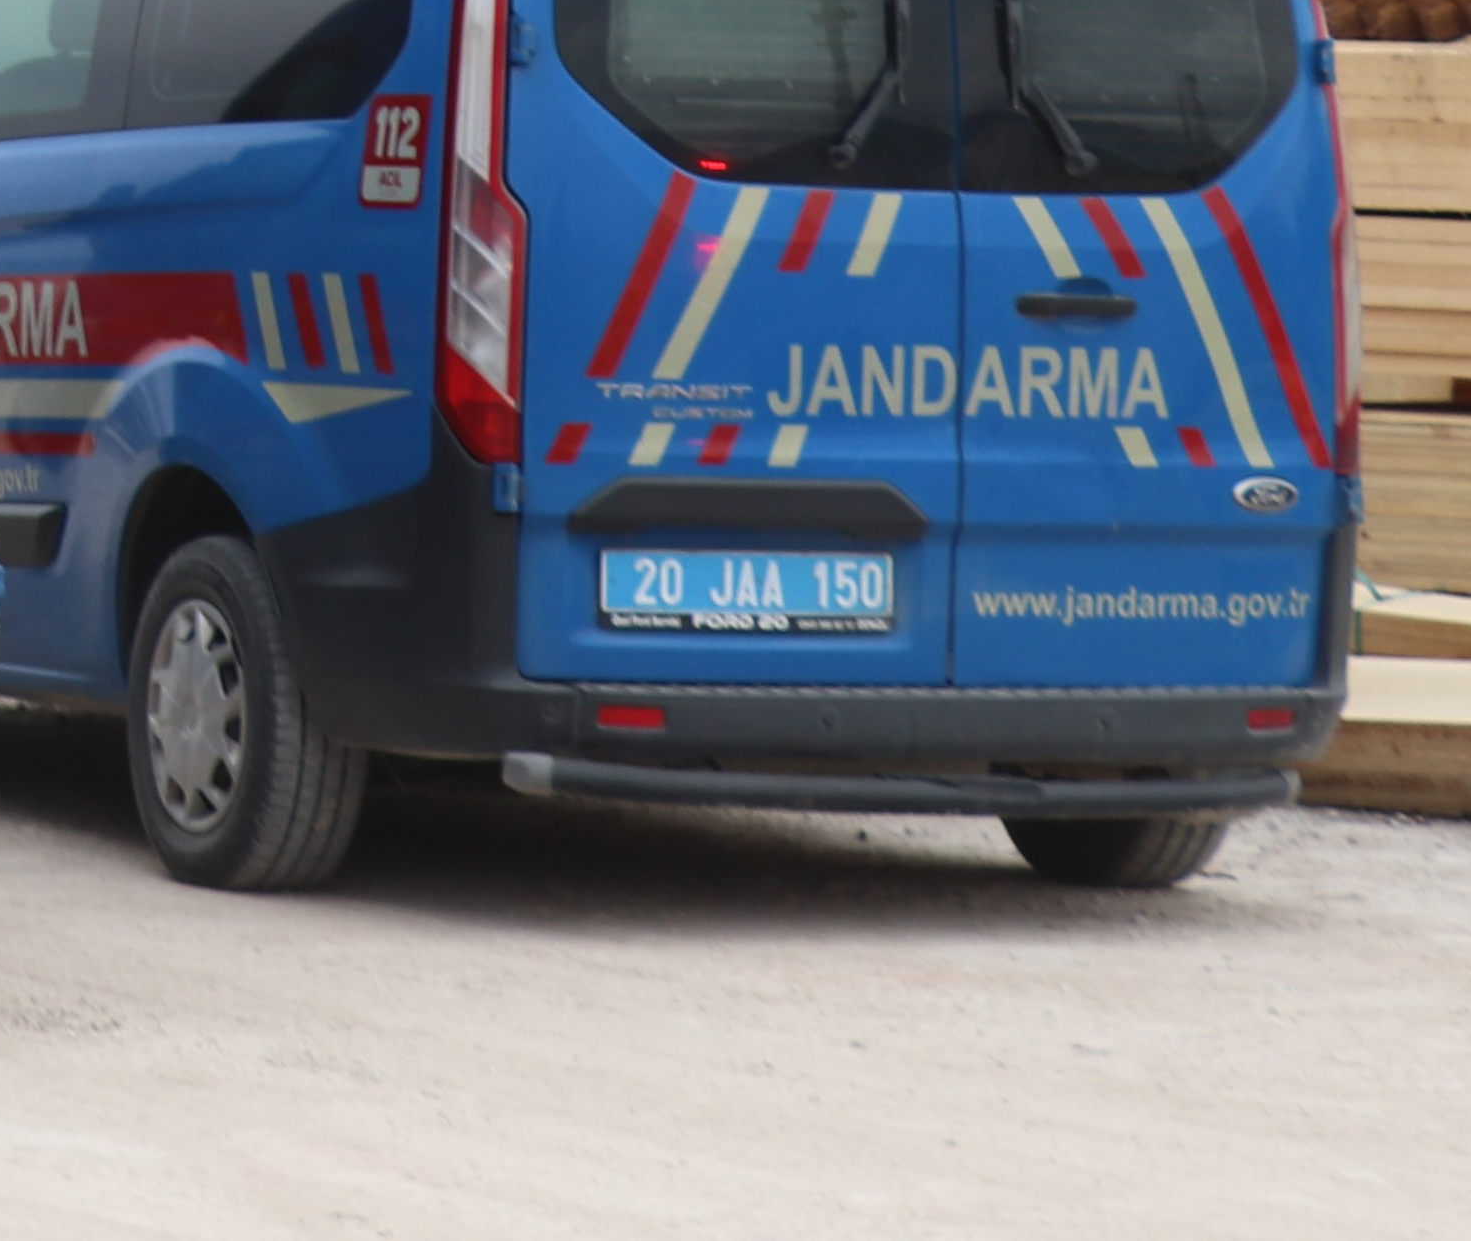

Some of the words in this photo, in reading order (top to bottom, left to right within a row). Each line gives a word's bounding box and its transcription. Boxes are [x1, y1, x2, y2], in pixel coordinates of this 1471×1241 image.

[374, 105, 421, 159] 112
[595, 381, 753, 401] TRANSIT
[766, 343, 1170, 420] JANDARMA
[652, 406, 755, 420] CUSTOM
[632, 557, 684, 607] 20
[710, 558, 786, 608] JAA
[813, 560, 884, 609] 150
[972, 585, 1312, 627] www.jandarma.gov.tr
